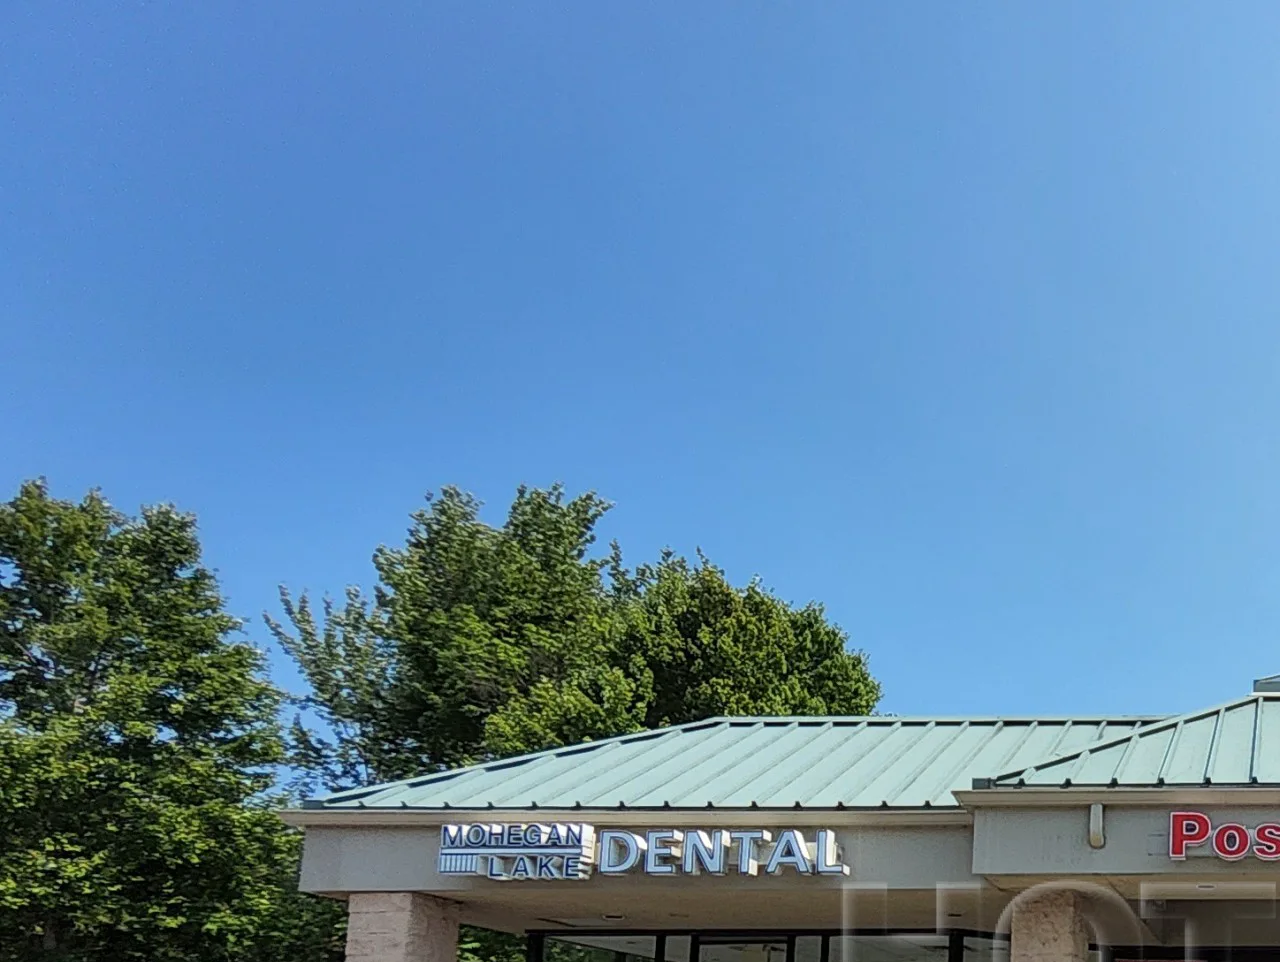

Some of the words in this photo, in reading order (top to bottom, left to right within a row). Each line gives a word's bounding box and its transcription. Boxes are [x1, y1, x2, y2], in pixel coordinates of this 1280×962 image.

[442, 824, 587, 847] MOHEGAN
[598, 829, 850, 876] DENTAL
[487, 855, 583, 880] LAKE
